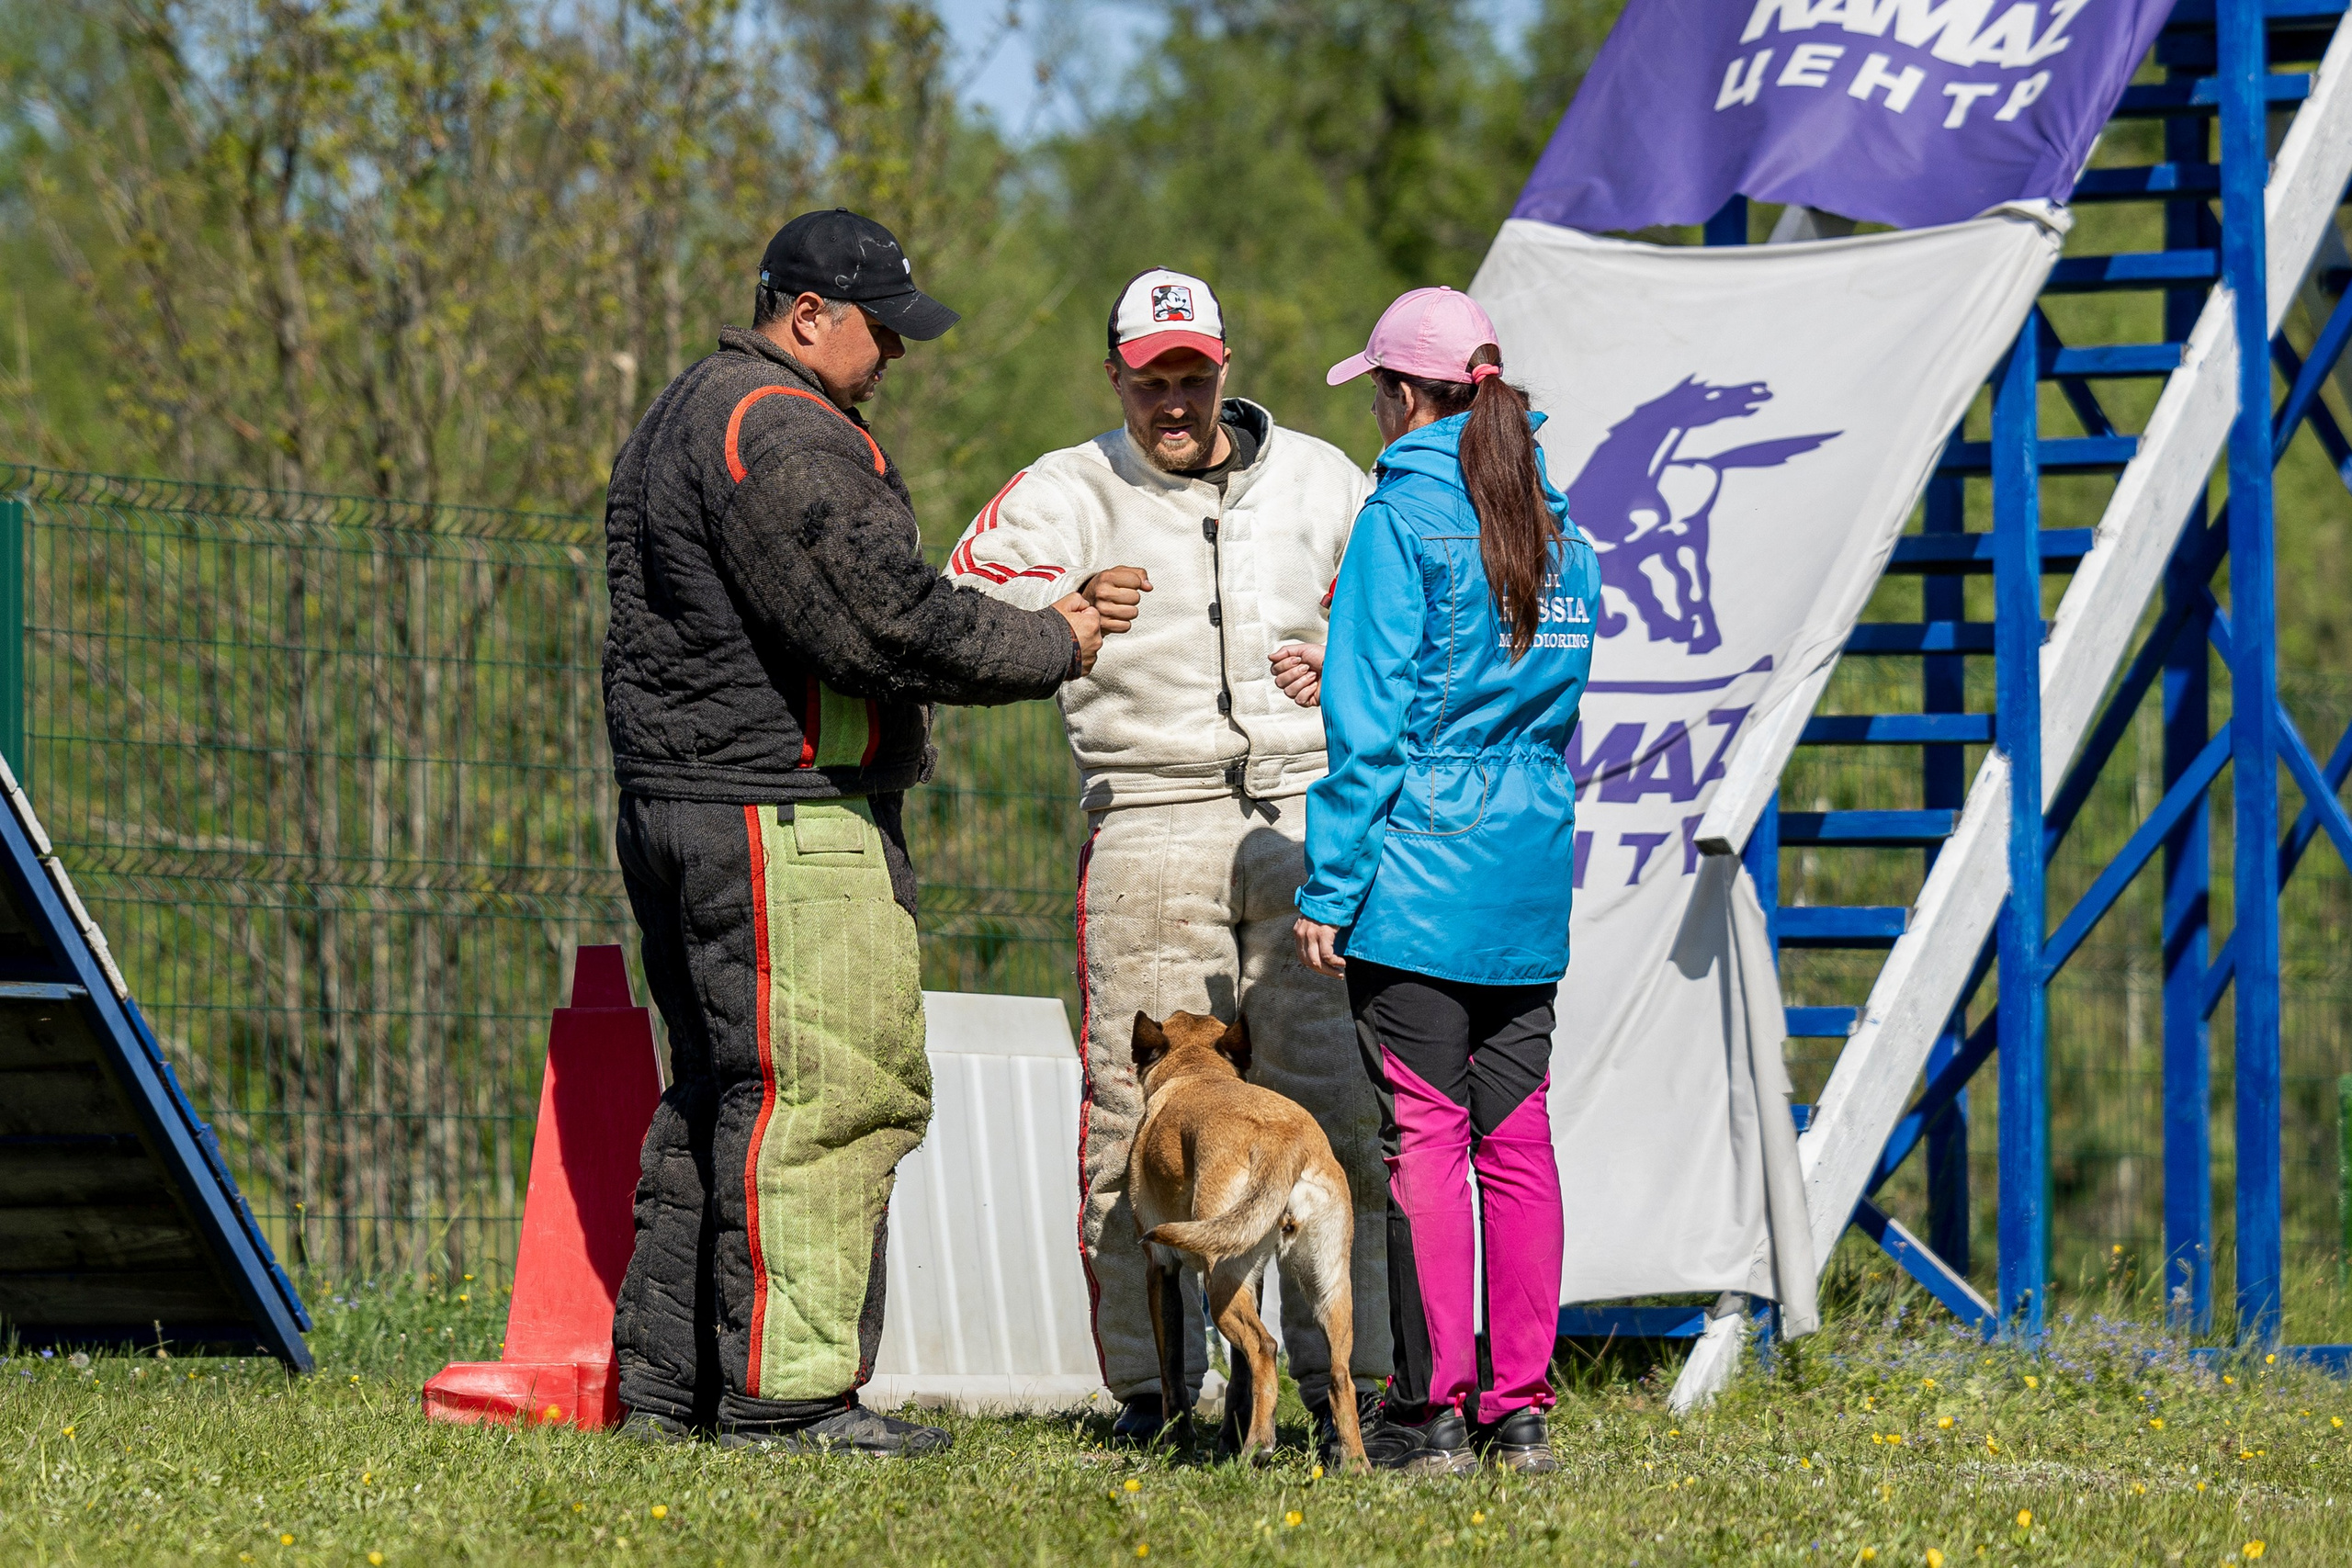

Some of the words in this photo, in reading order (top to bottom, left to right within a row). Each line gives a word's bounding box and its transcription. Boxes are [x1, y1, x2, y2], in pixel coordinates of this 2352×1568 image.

[1714, 43, 2052, 130] ЦЕНТР
[1499, 595, 1590, 624] RSSIA
[1498, 633, 1589, 649] MDIORING
[1565, 702, 1756, 805] MAZ
